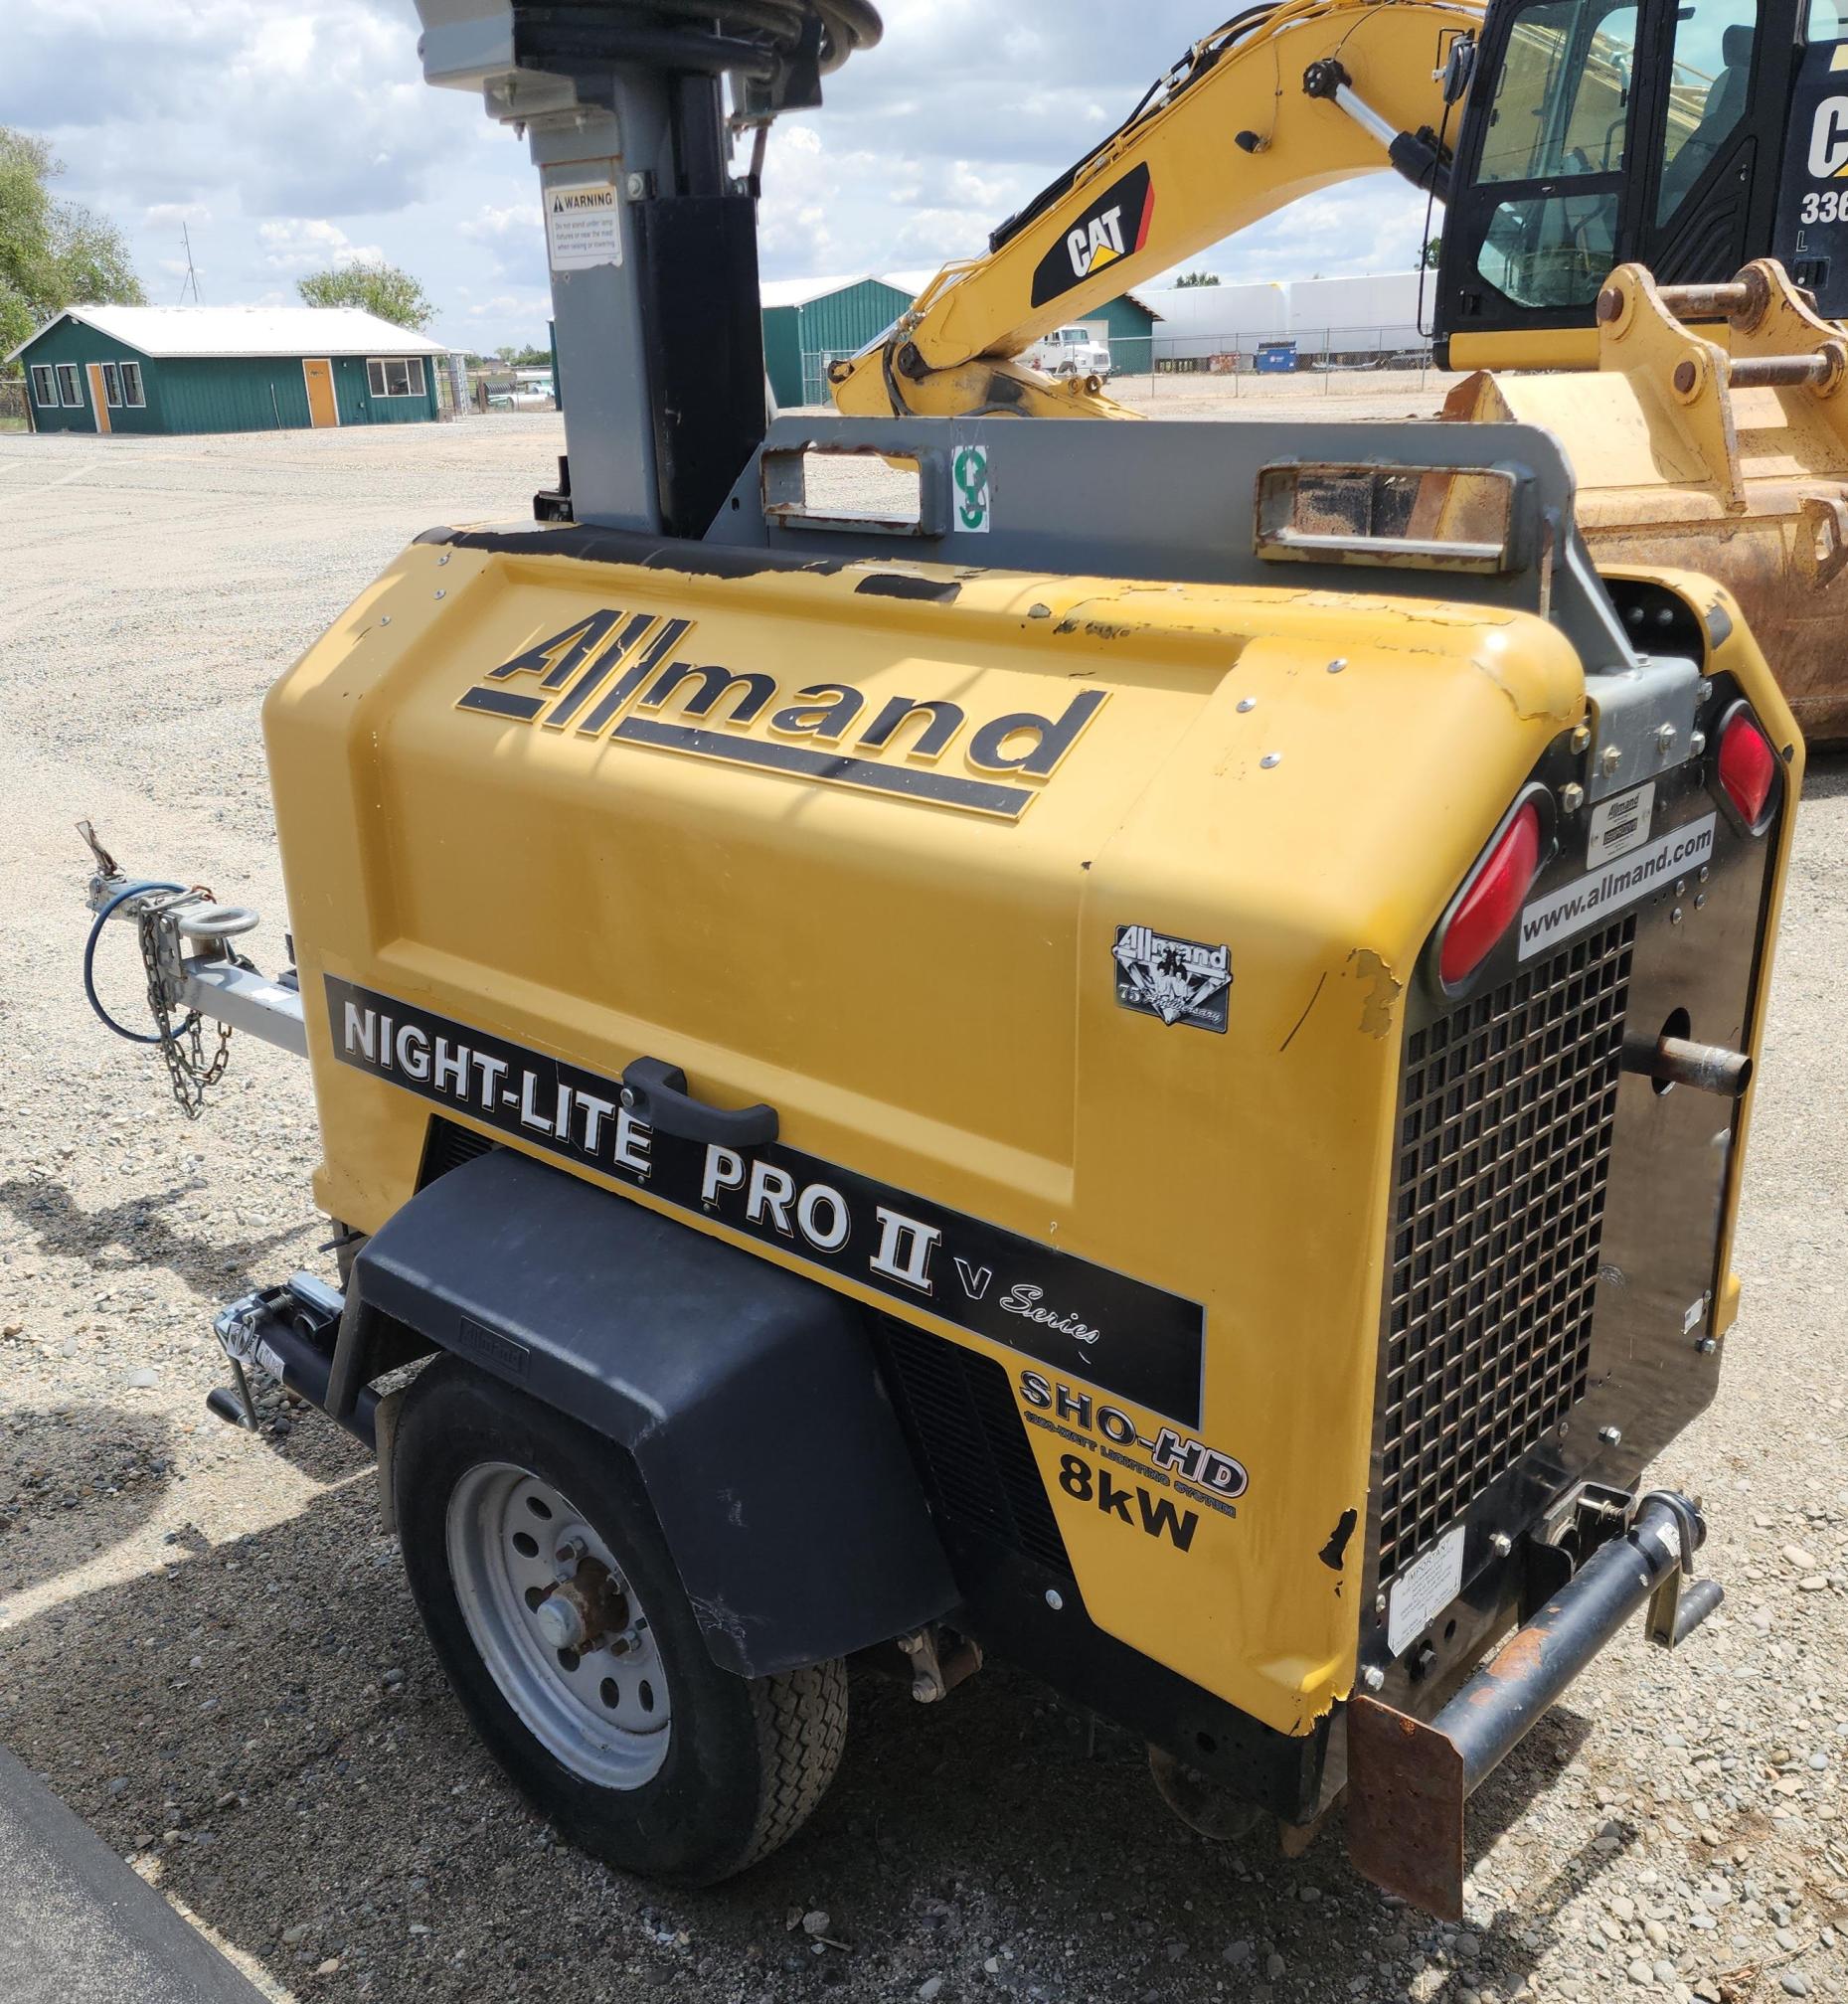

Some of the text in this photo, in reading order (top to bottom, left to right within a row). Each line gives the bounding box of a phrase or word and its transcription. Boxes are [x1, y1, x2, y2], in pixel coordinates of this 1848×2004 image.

[565, 192, 612, 209] WARNING
[1067, 205, 1124, 277] CAT
[1796, 231, 1807, 251] L
[483, 608, 1114, 781] Allmand
[1523, 829, 1712, 942] www.allmand.com
[1116, 924, 1228, 970] Allmand
[343, 1000, 1100, 1345] NIGHT-LITE PRO II V Series
[1019, 1370, 1249, 1499] SHO-HD
[1059, 1453, 1199, 1553] 8kW
